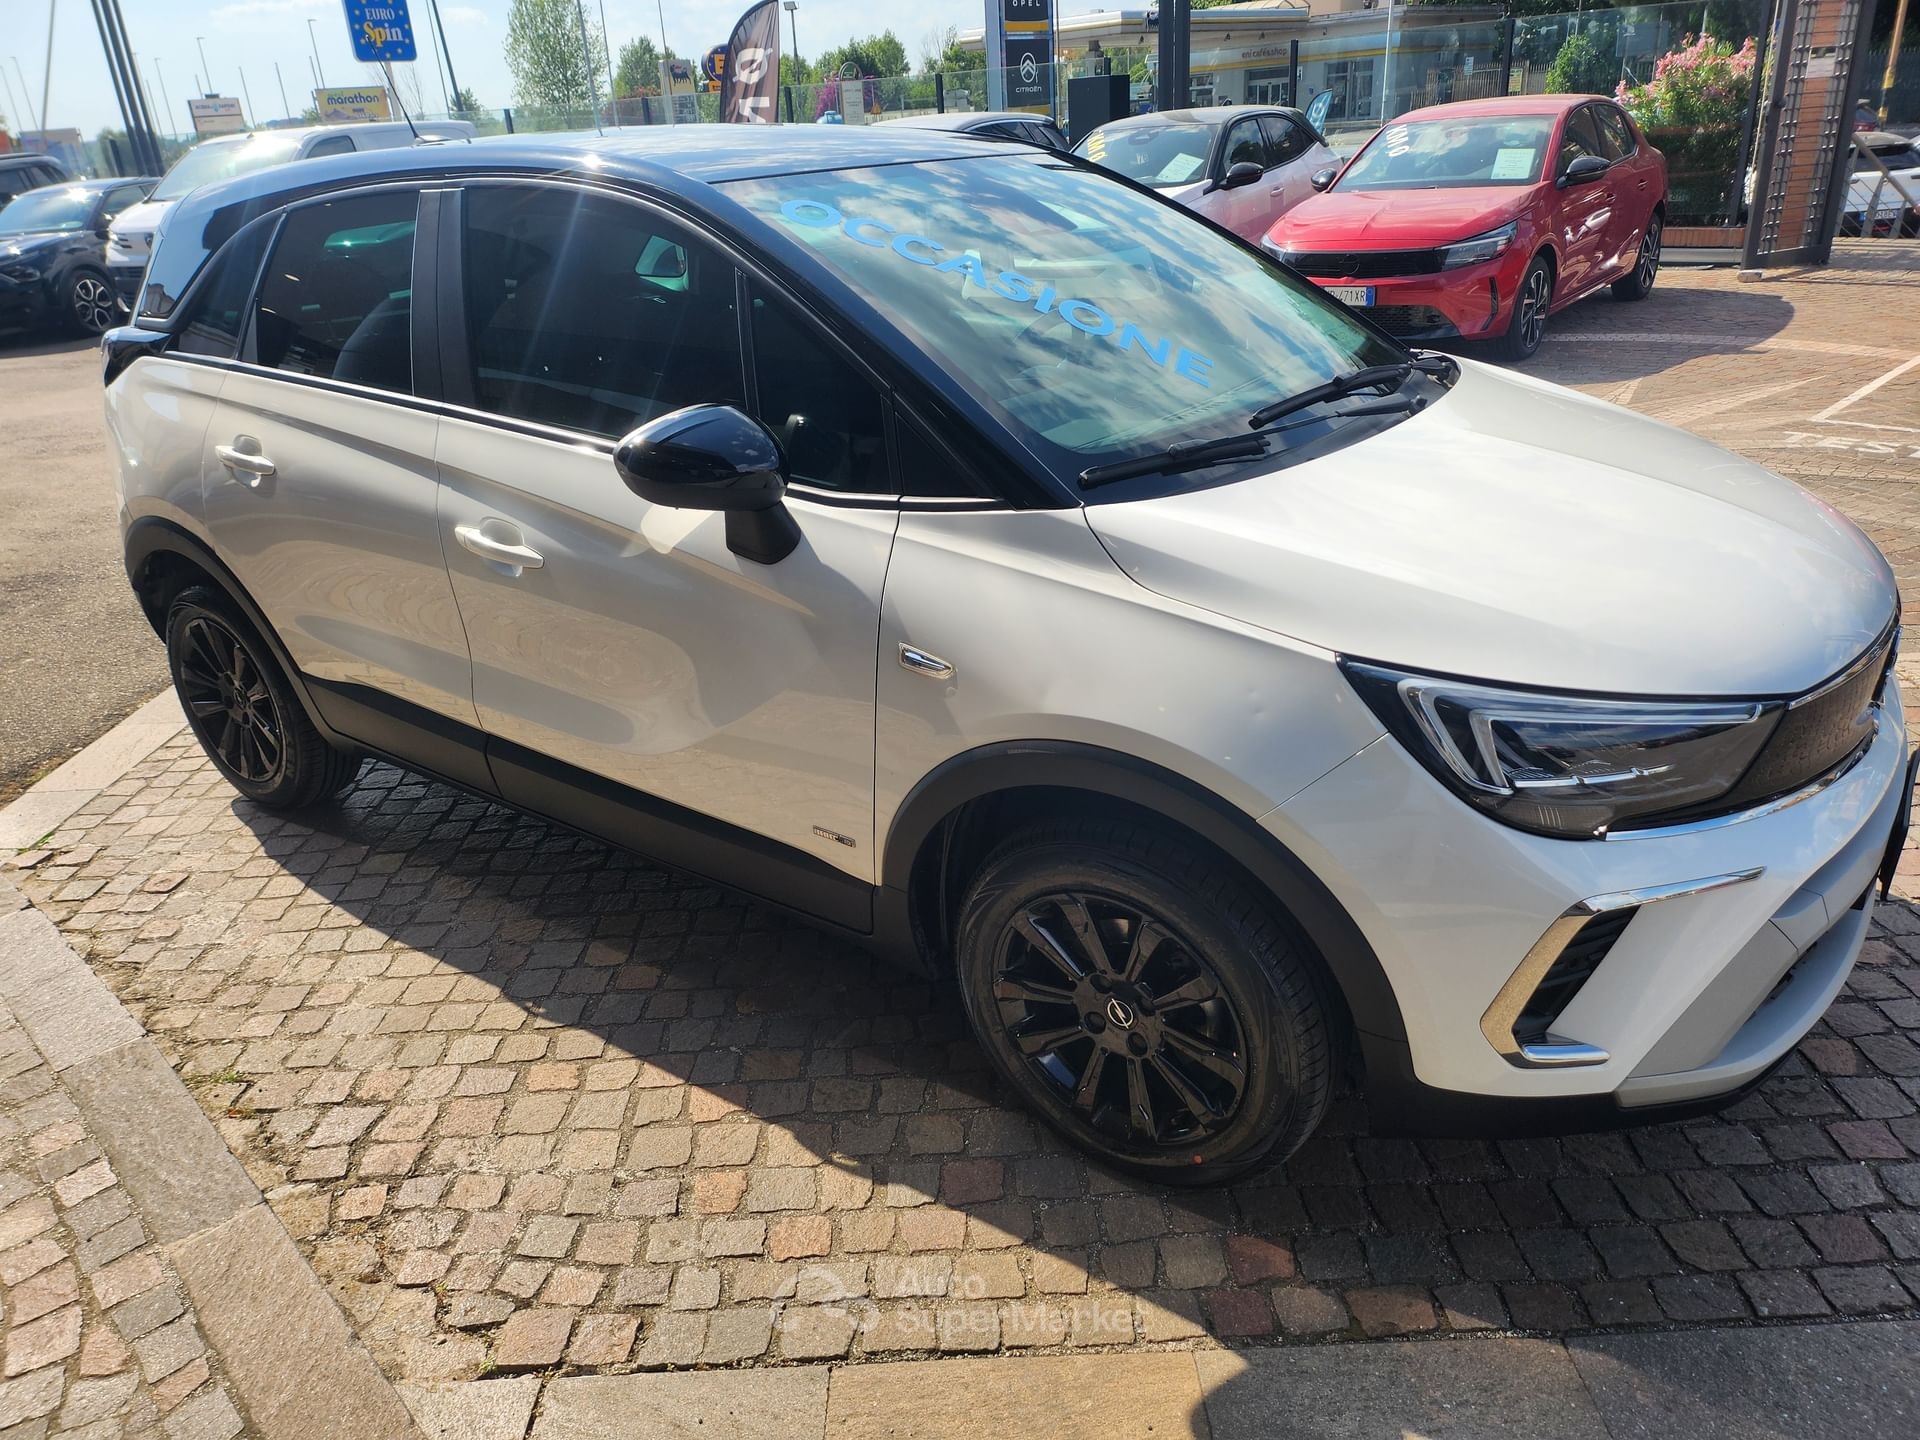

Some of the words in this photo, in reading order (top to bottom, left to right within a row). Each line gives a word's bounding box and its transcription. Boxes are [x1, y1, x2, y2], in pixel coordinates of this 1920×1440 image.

[364, 7, 396, 20] EURO
[363, 21, 404, 47] Spin
[326, 92, 380, 105] marathon
[780, 198, 1215, 388] OCCASIONE
